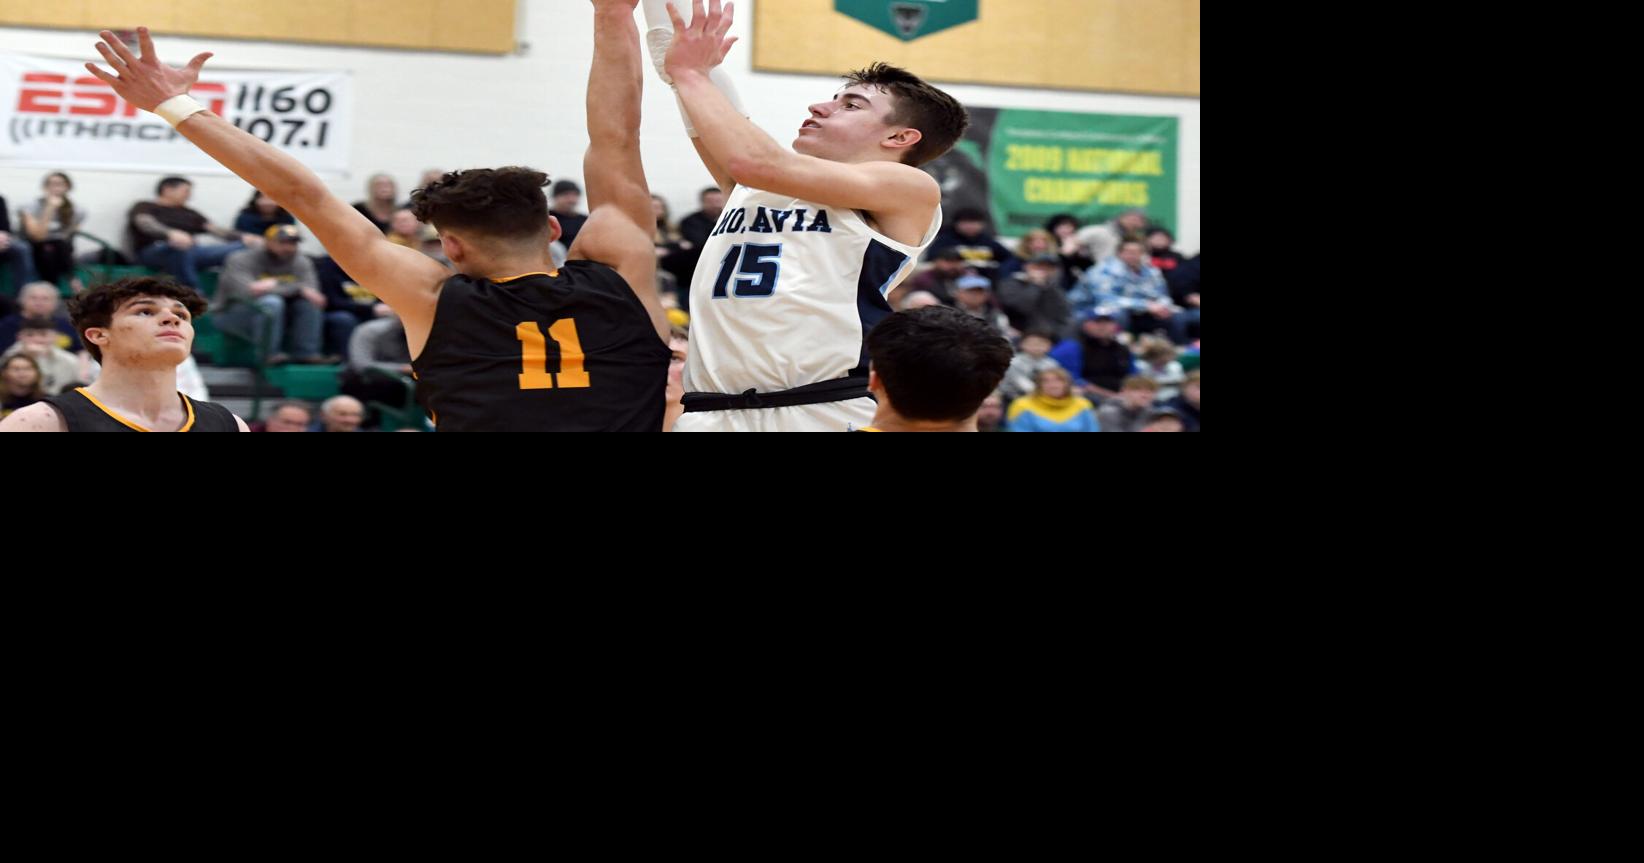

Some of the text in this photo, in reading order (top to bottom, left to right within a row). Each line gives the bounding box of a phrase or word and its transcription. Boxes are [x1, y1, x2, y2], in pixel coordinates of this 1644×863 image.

[237, 85, 331, 114] 1160
[38, 119, 178, 141] ITHAC
[711, 206, 832, 236] MOAVIA
[711, 242, 783, 299] 15
[515, 318, 591, 389] 11
